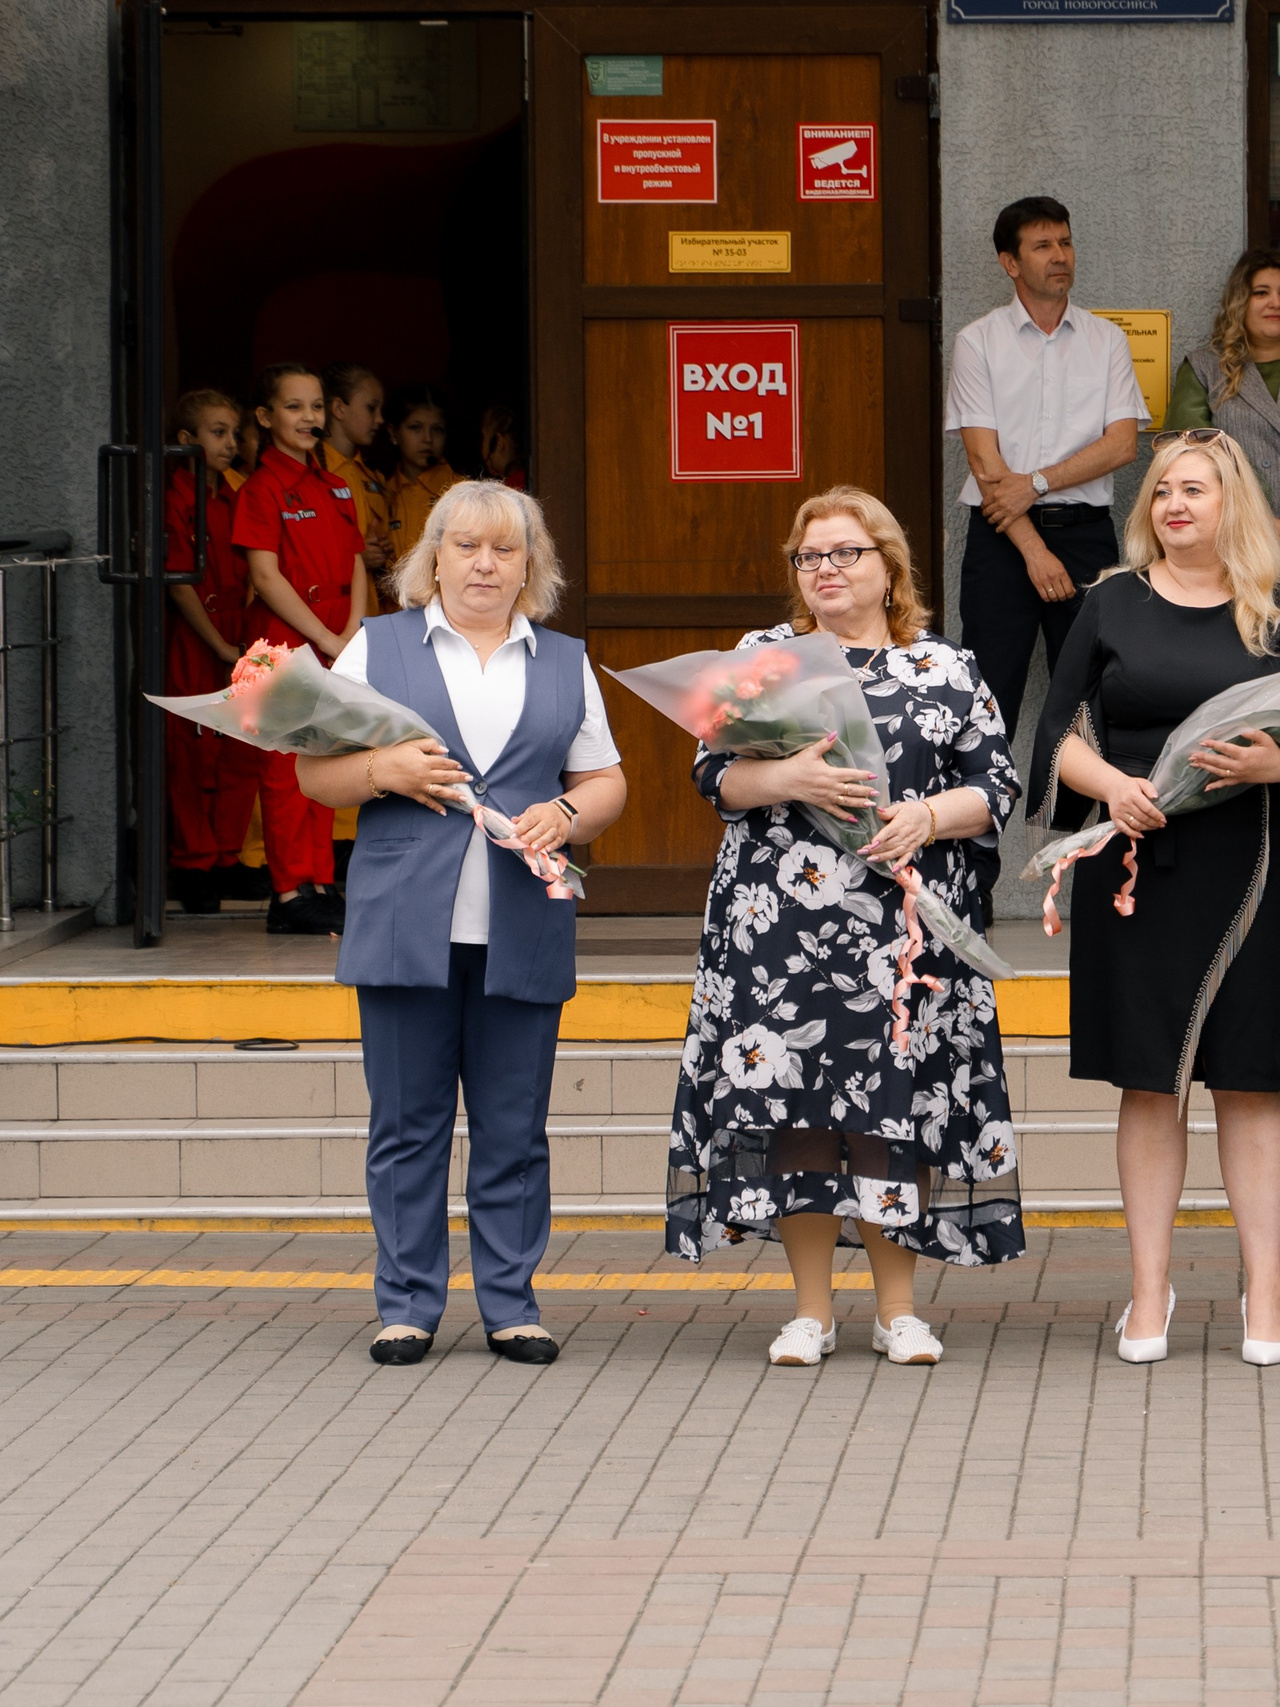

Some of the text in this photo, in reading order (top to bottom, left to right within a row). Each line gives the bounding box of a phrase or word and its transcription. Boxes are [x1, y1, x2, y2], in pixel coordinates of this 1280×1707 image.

[1023, 0, 1060, 10] ГОРОД
[804, 129, 870, 138] ВНИМАНИЕ!!!
[603, 133, 711, 145] В учреждении установлен
[633, 148, 681, 159] пропускной
[614, 165, 620, 173] и
[643, 179, 672, 189] режим
[814, 179, 860, 188] ВЕДЕТСЯ
[680, 237, 778, 247] Избирательный участок
[683, 362, 787, 396] ВХОД
[706, 411, 763, 440] №1
